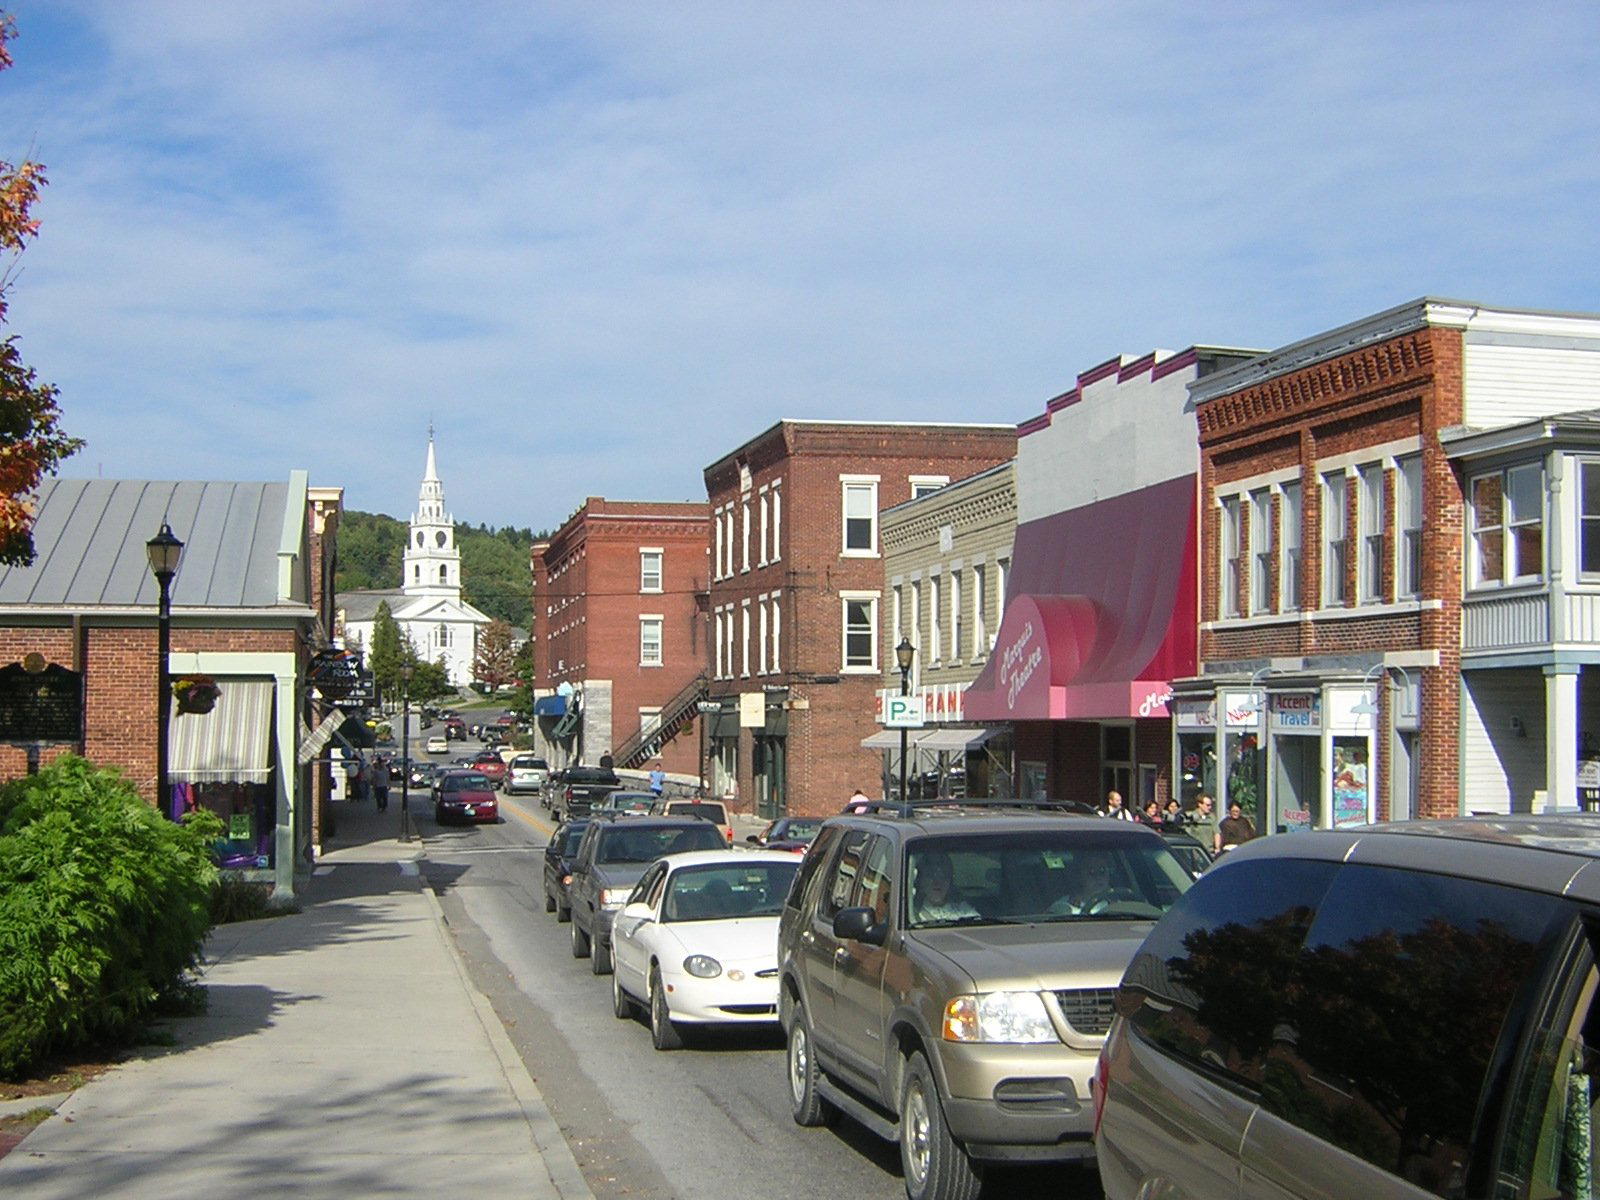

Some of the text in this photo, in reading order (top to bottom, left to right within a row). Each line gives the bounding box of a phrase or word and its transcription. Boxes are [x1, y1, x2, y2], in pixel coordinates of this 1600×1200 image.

[1001, 621, 1032, 684] Marquis
[1008, 646, 1042, 710] Theatre
[1276, 693, 1311, 710] Accent
[1279, 711, 1311, 726] Travel
